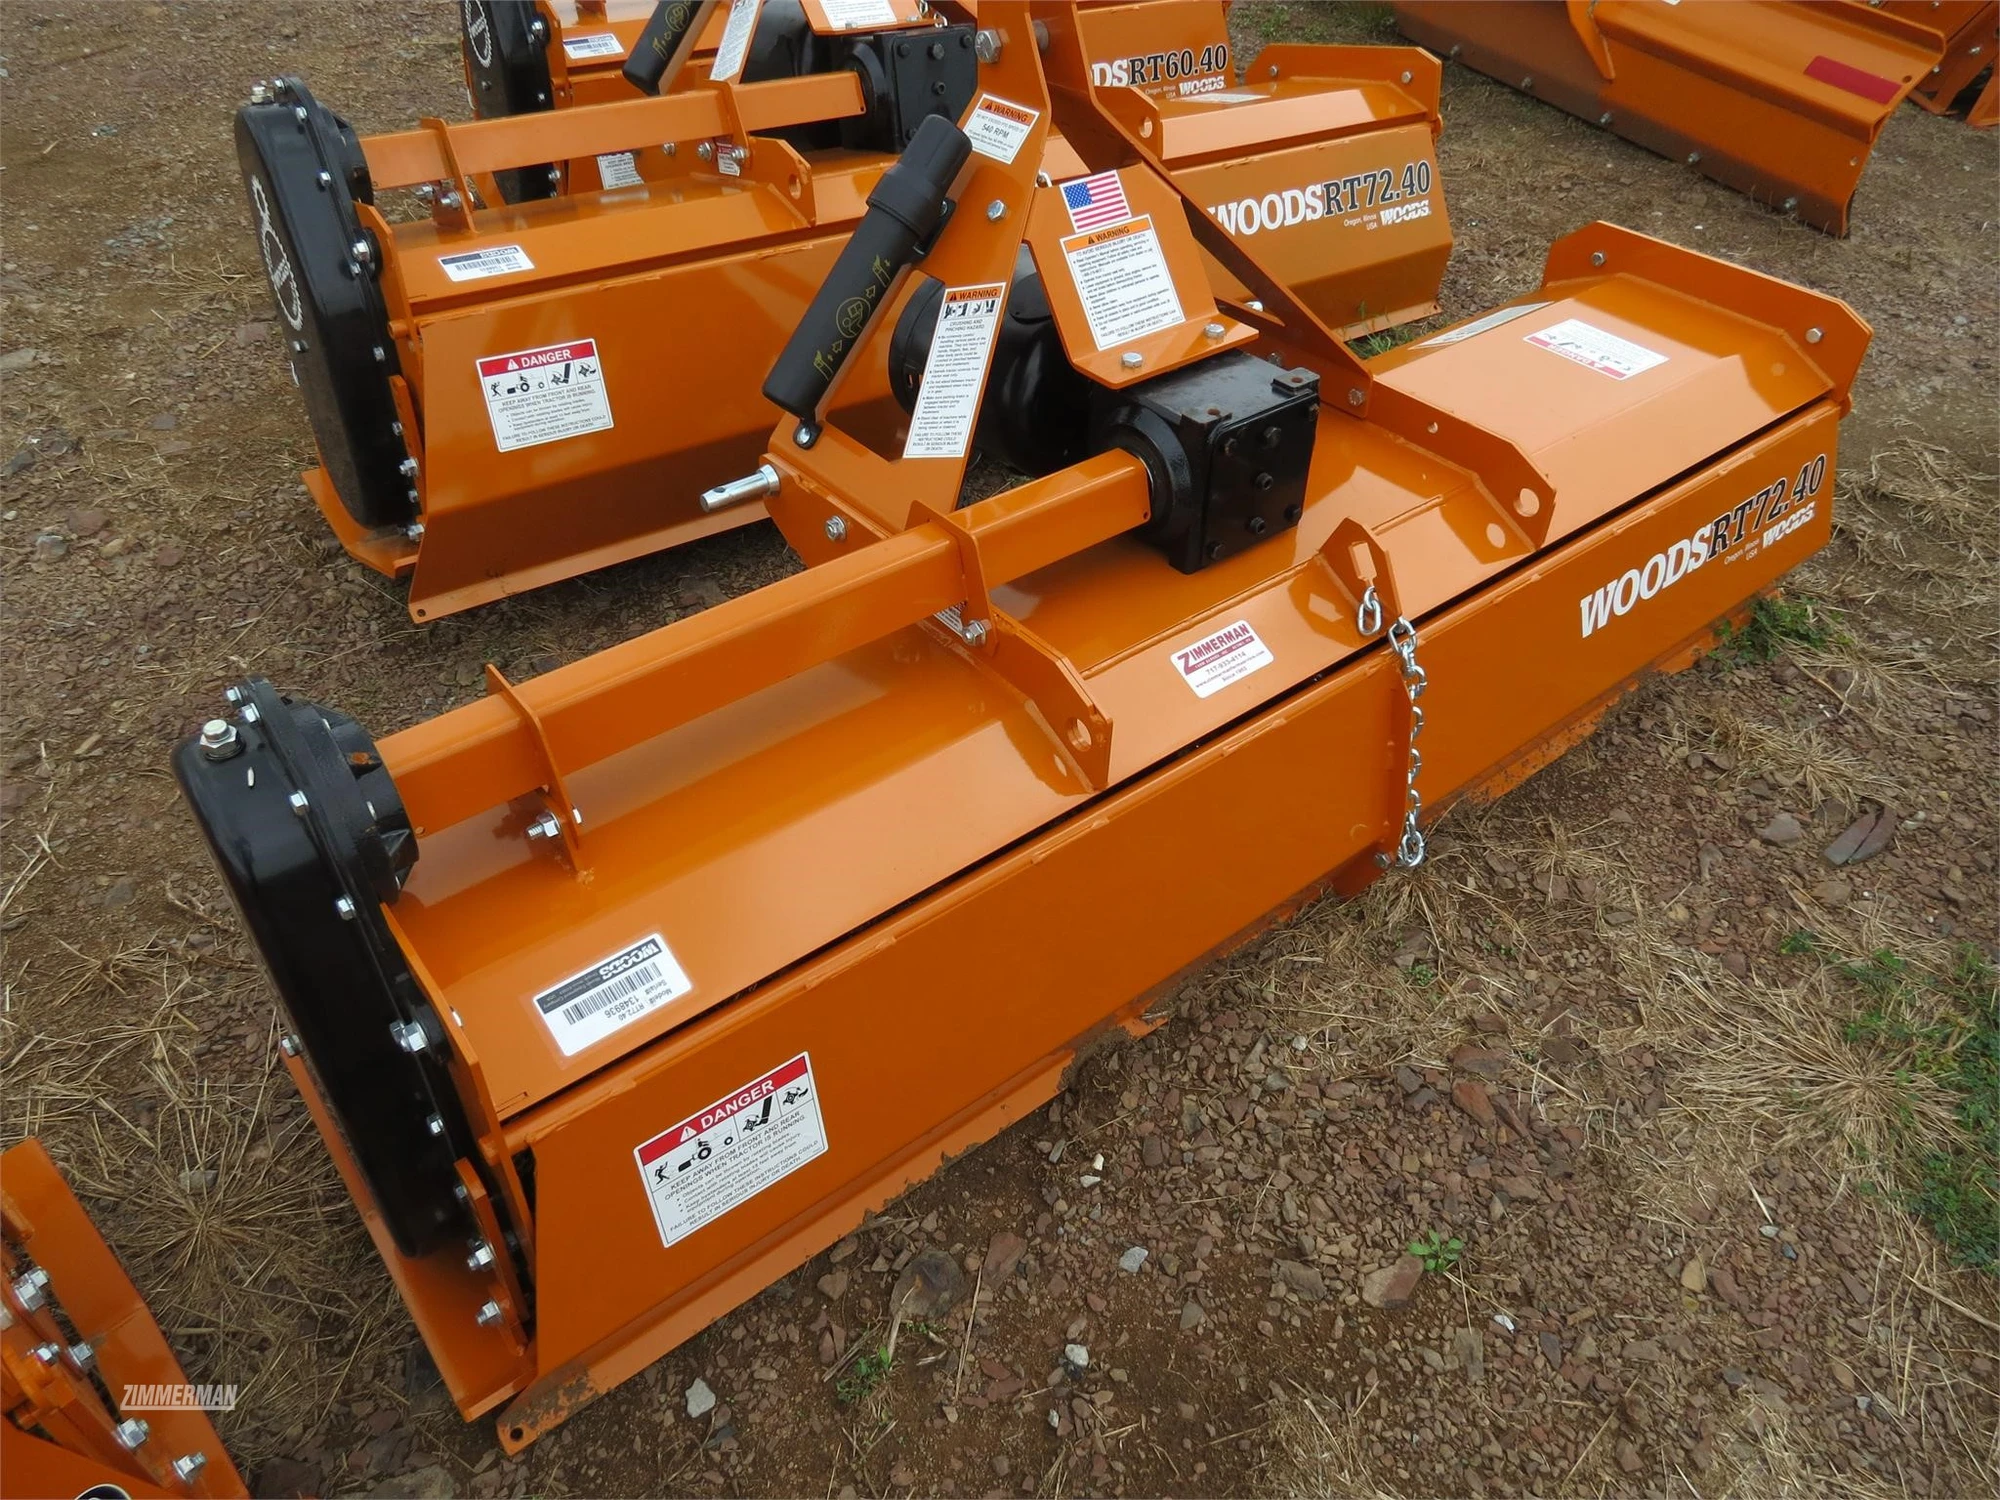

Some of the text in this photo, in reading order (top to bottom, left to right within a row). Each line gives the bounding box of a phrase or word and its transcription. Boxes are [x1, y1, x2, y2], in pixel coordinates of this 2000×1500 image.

[1179, 75, 1225, 96] WOODS
[992, 127, 1010, 138] RPM
[993, 103, 1029, 122] WARNING
[1380, 200, 1430, 226] WOODS
[1095, 226, 1130, 242] WARNING
[958, 288, 998, 299] WARNING
[520, 348, 571, 368] DANGER
[1762, 501, 1816, 549] WOODS
[1177, 623, 1251, 676] ZIMMERMAN
[597, 940, 659, 980] WOODS
[603, 994, 639, 1018] 1348936
[617, 1002, 645, 1022] RT72.40
[700, 1078, 774, 1130] DANGER
[664, 1114, 805, 1200] OPENINGS WHEN TRACTOR IS RUNNING
[670, 1110, 800, 1190] KEEP AWAY FROM FRONT AND REAR
[682, 1182, 703, 1198] Objects
[704, 1176, 714, 1185] can
[715, 1171, 722, 1179] be
[723, 1159, 742, 1174] thrown
[743, 1155, 750, 1163] by
[751, 1142, 771, 1158] rotating
[669, 1212, 696, 1231] FAILURE
[697, 1206, 705, 1215] TO
[706, 1190, 733, 1210] FOLLOW
[733, 1178, 753, 1193] THESE
[754, 1152, 797, 1181] INSTRUCTIONS
[798, 1139, 818, 1155] COULD
[683, 1187, 705, 1204] Contact
[705, 1180, 717, 1191] with
[718, 1167, 739, 1183] rotating
[740, 1156, 757, 1170] blades
[759, 1151, 767, 1159] will
[768, 1141, 784, 1154] cause
[689, 1208, 713, 1226] RESULT
[714, 1203, 721, 1211] IN
[721, 1187, 748, 1206] SERIOUS
[748, 1174, 770, 1190] INJURY
[771, 1168, 779, 1177] OR
